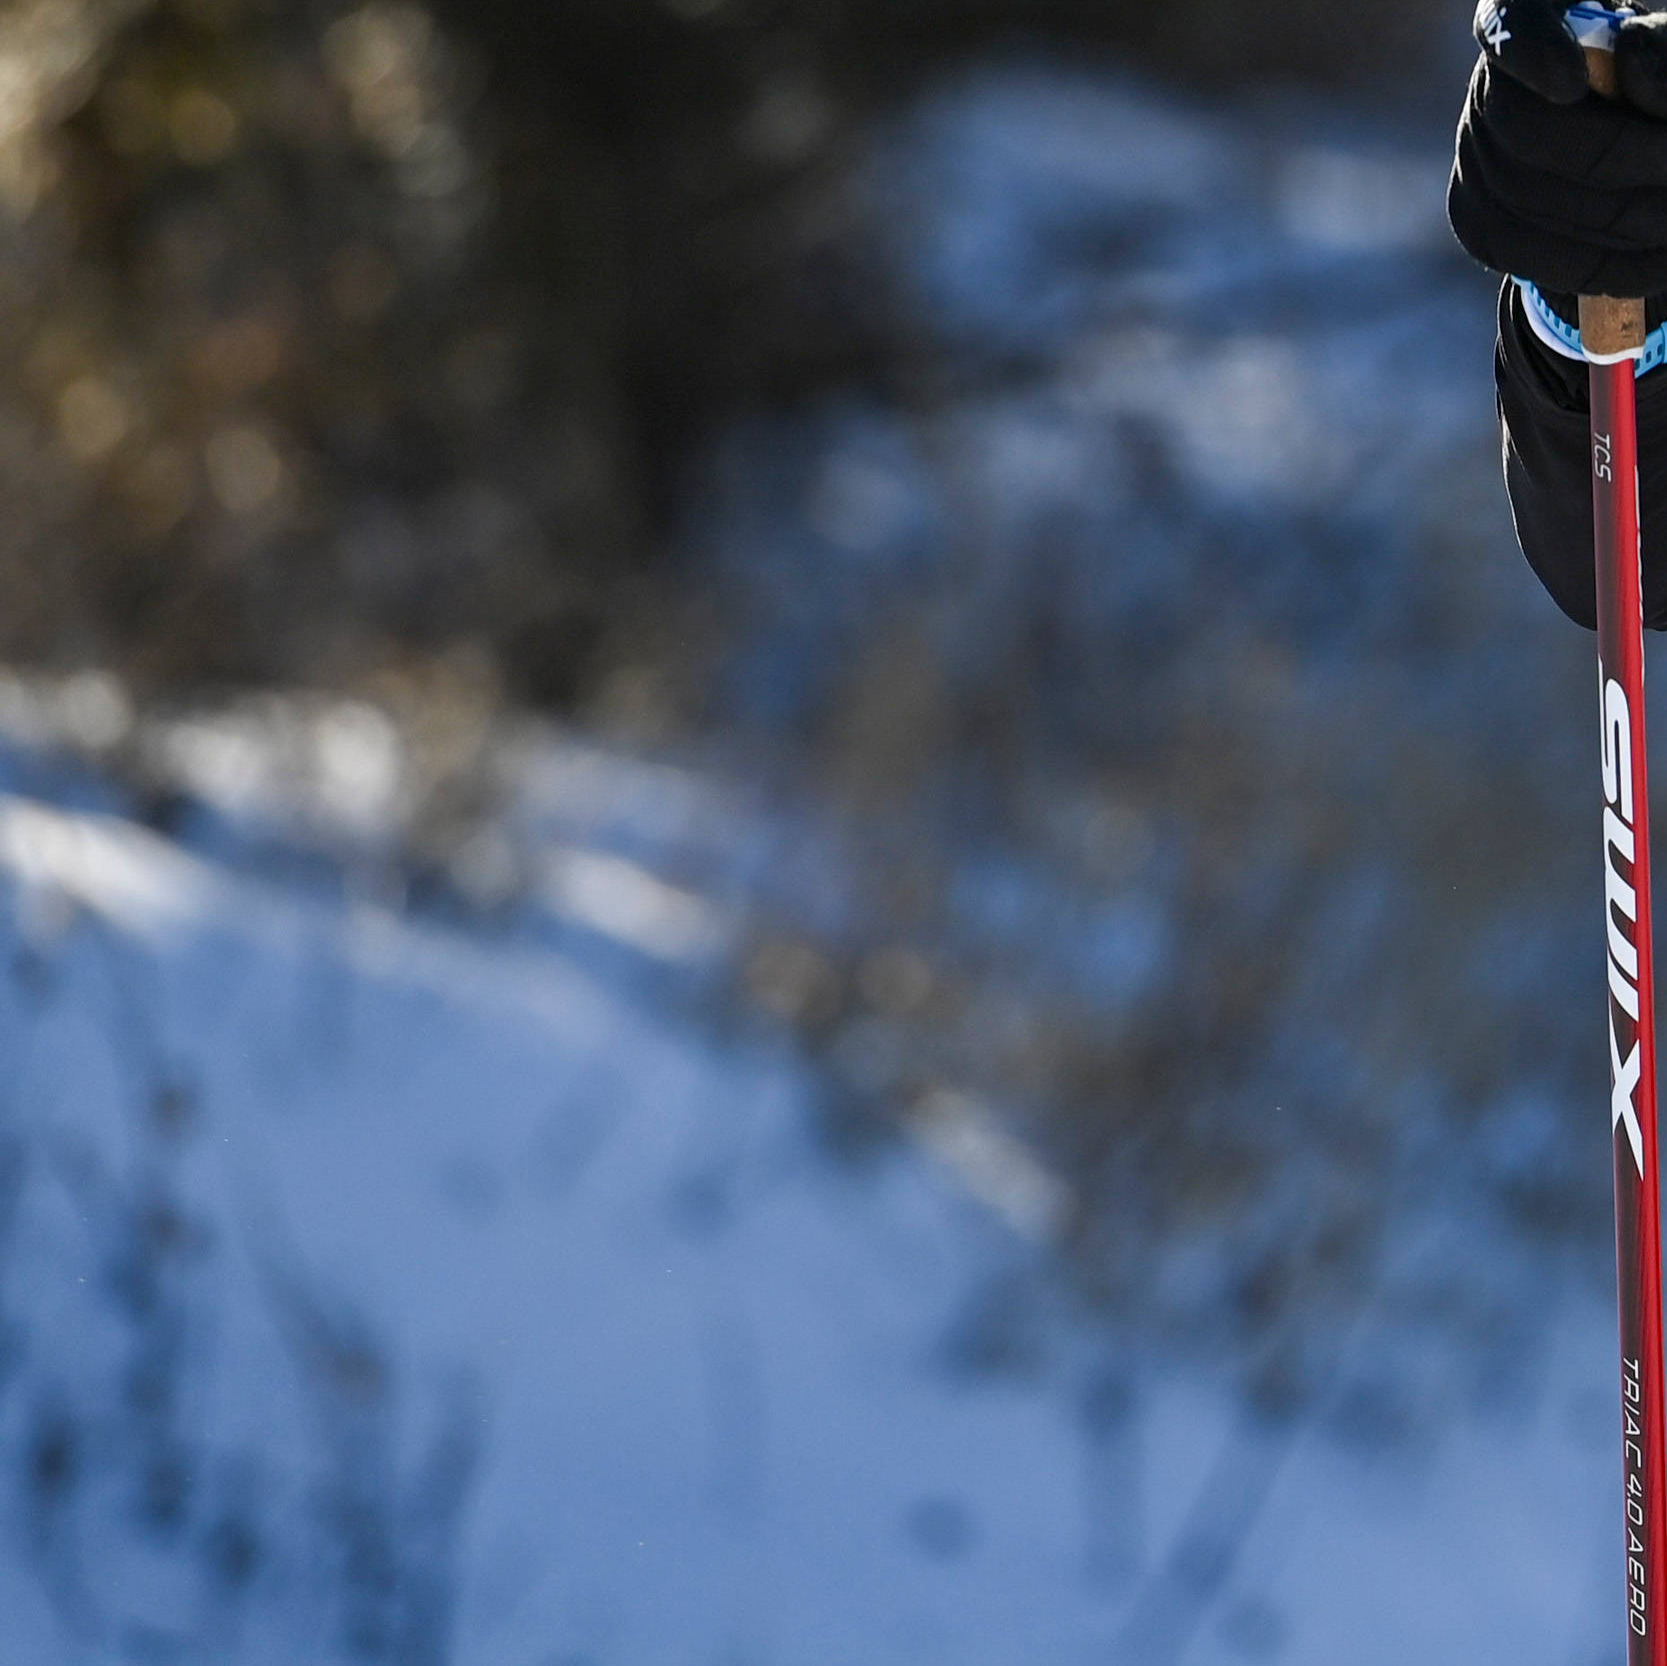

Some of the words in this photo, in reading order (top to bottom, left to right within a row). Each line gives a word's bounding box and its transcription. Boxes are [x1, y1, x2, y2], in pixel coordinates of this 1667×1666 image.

[1593, 432, 1611, 483] TCS
[1601, 678, 1644, 1181] SWIX
[1623, 1357, 1642, 1468] TRIAC
[1626, 1473, 1644, 1526] 4.0
[1628, 1527, 1646, 1637] AERO
